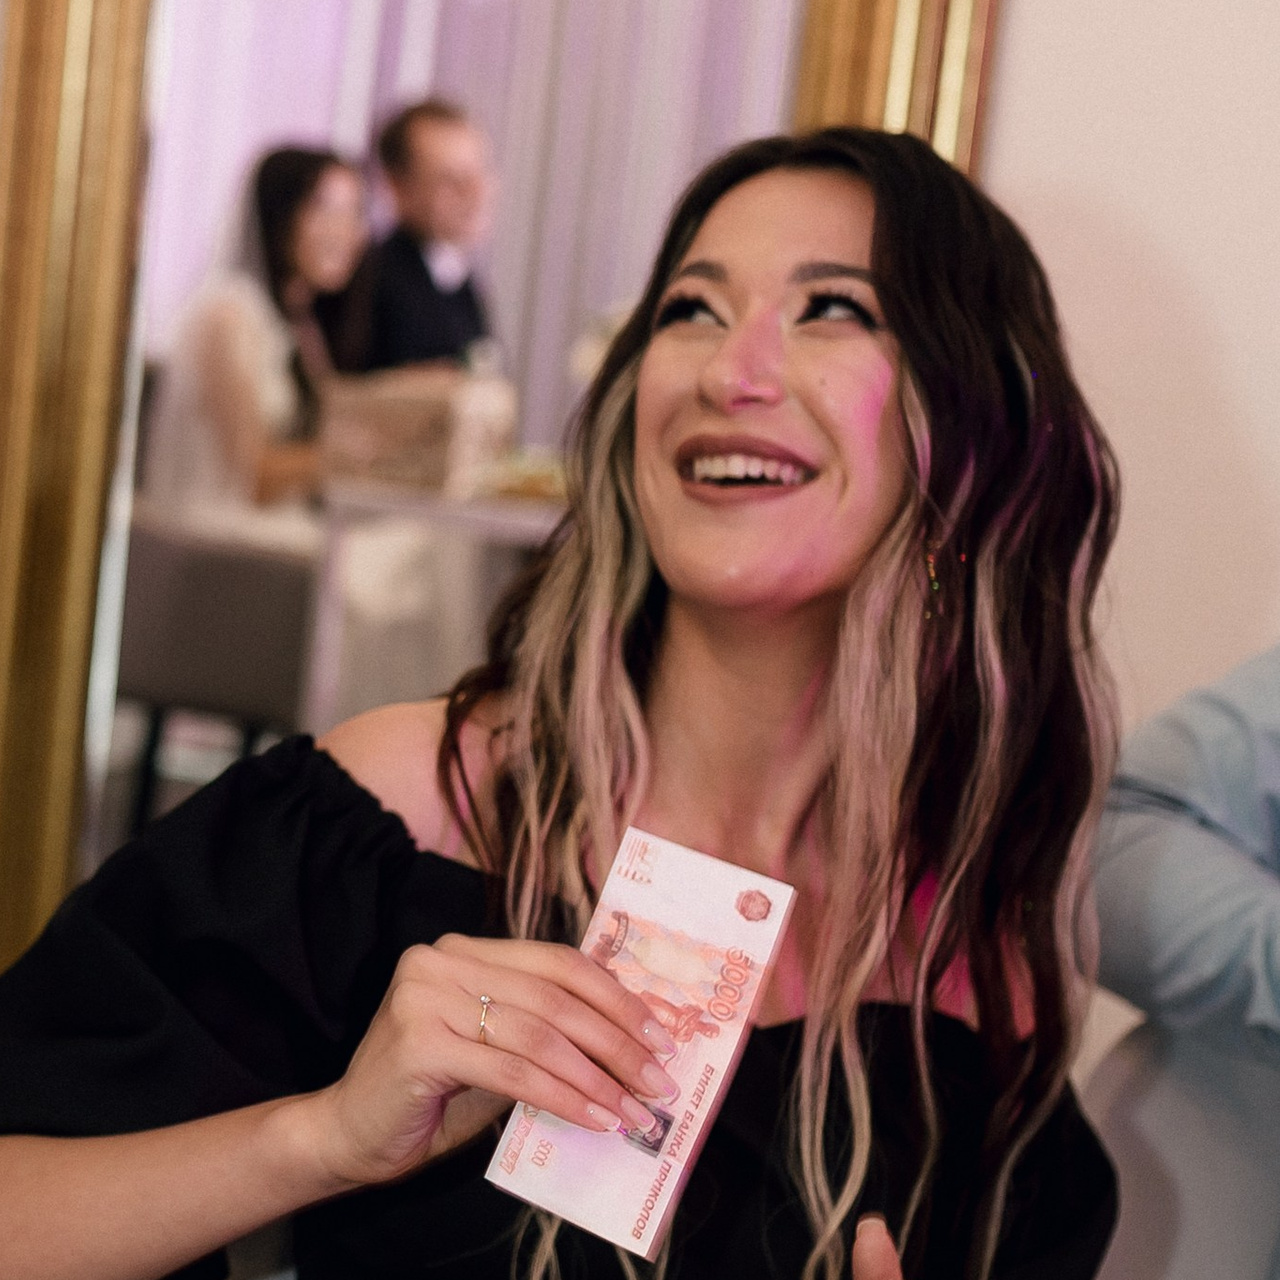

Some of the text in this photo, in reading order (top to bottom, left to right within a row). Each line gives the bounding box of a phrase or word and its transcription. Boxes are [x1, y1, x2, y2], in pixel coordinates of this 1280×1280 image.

[707, 947, 755, 1022] 5000
[499, 1103, 540, 1175] УБЛЕЙ
[530, 1138, 553, 1168] 5000
[631, 1063, 715, 1240] БИЛЕТ БАНКА ПРИКОЛОВ
